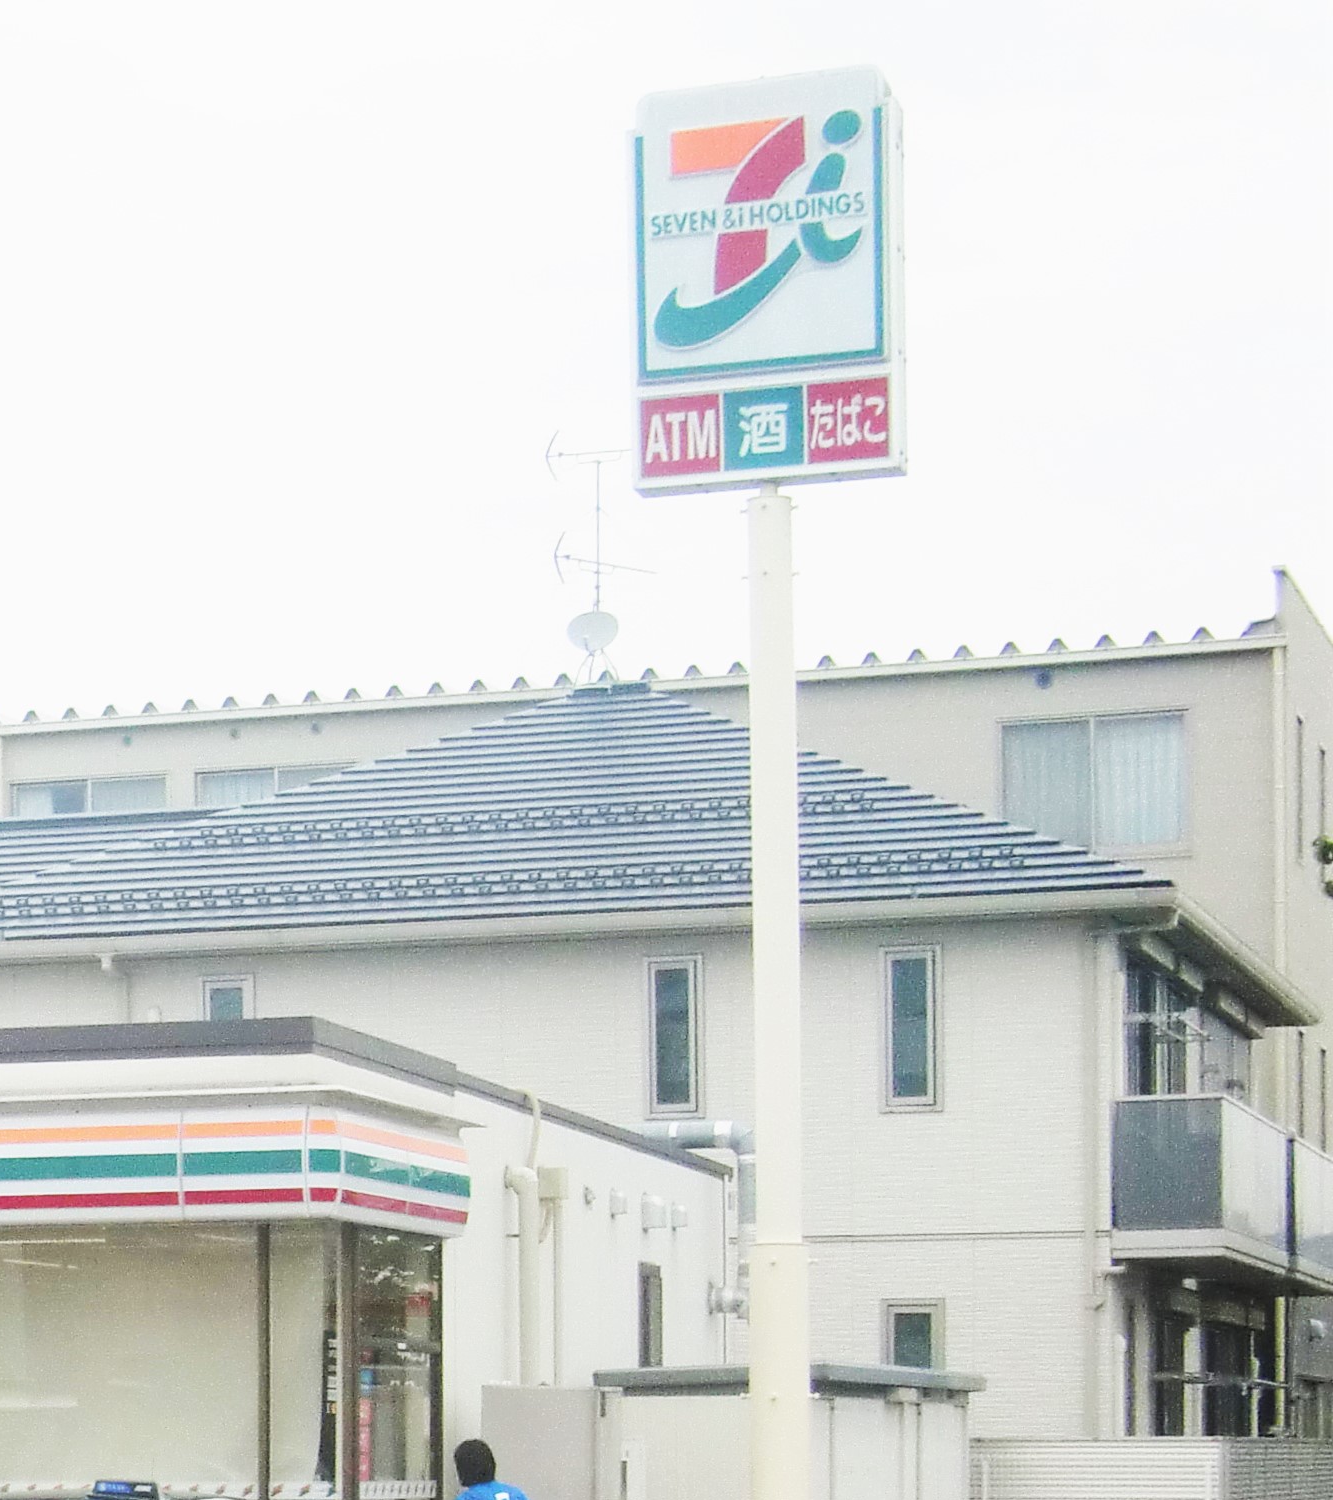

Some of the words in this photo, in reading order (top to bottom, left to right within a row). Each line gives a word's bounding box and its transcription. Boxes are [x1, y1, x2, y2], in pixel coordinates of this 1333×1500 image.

[651, 208, 717, 236] SEVEN
[749, 191, 866, 226] HOLDINGS
[645, 409, 718, 464] ATM
[738, 403, 788, 457] 酒
[809, 394, 887, 450] たばこ
